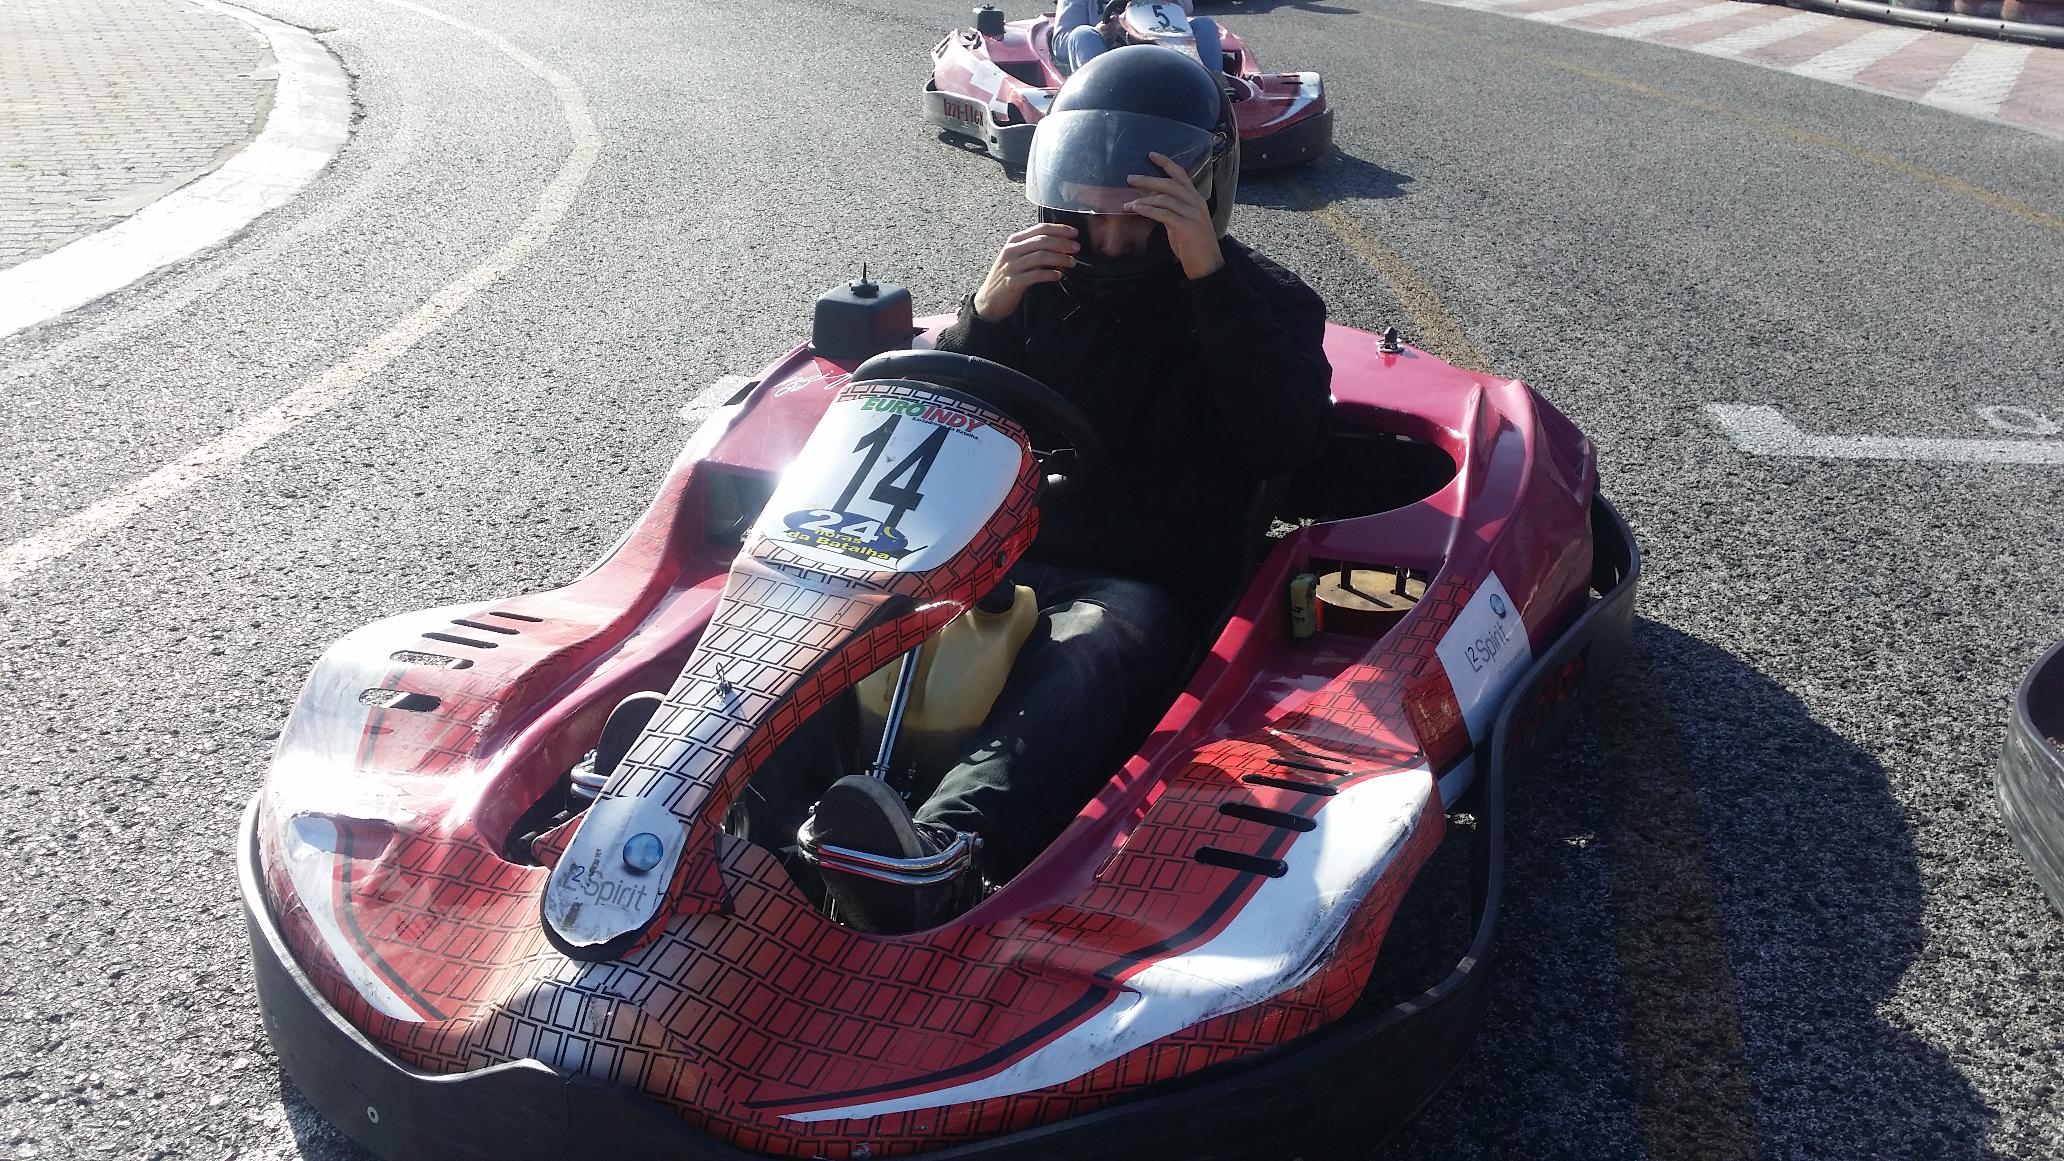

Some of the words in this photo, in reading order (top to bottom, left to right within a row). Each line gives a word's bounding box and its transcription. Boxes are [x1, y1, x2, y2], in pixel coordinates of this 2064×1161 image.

[1152, 4, 1170, 29] 5
[832, 413, 950, 529] 14
[798, 509, 882, 543] 24
[816, 536, 890, 560] Batalha
